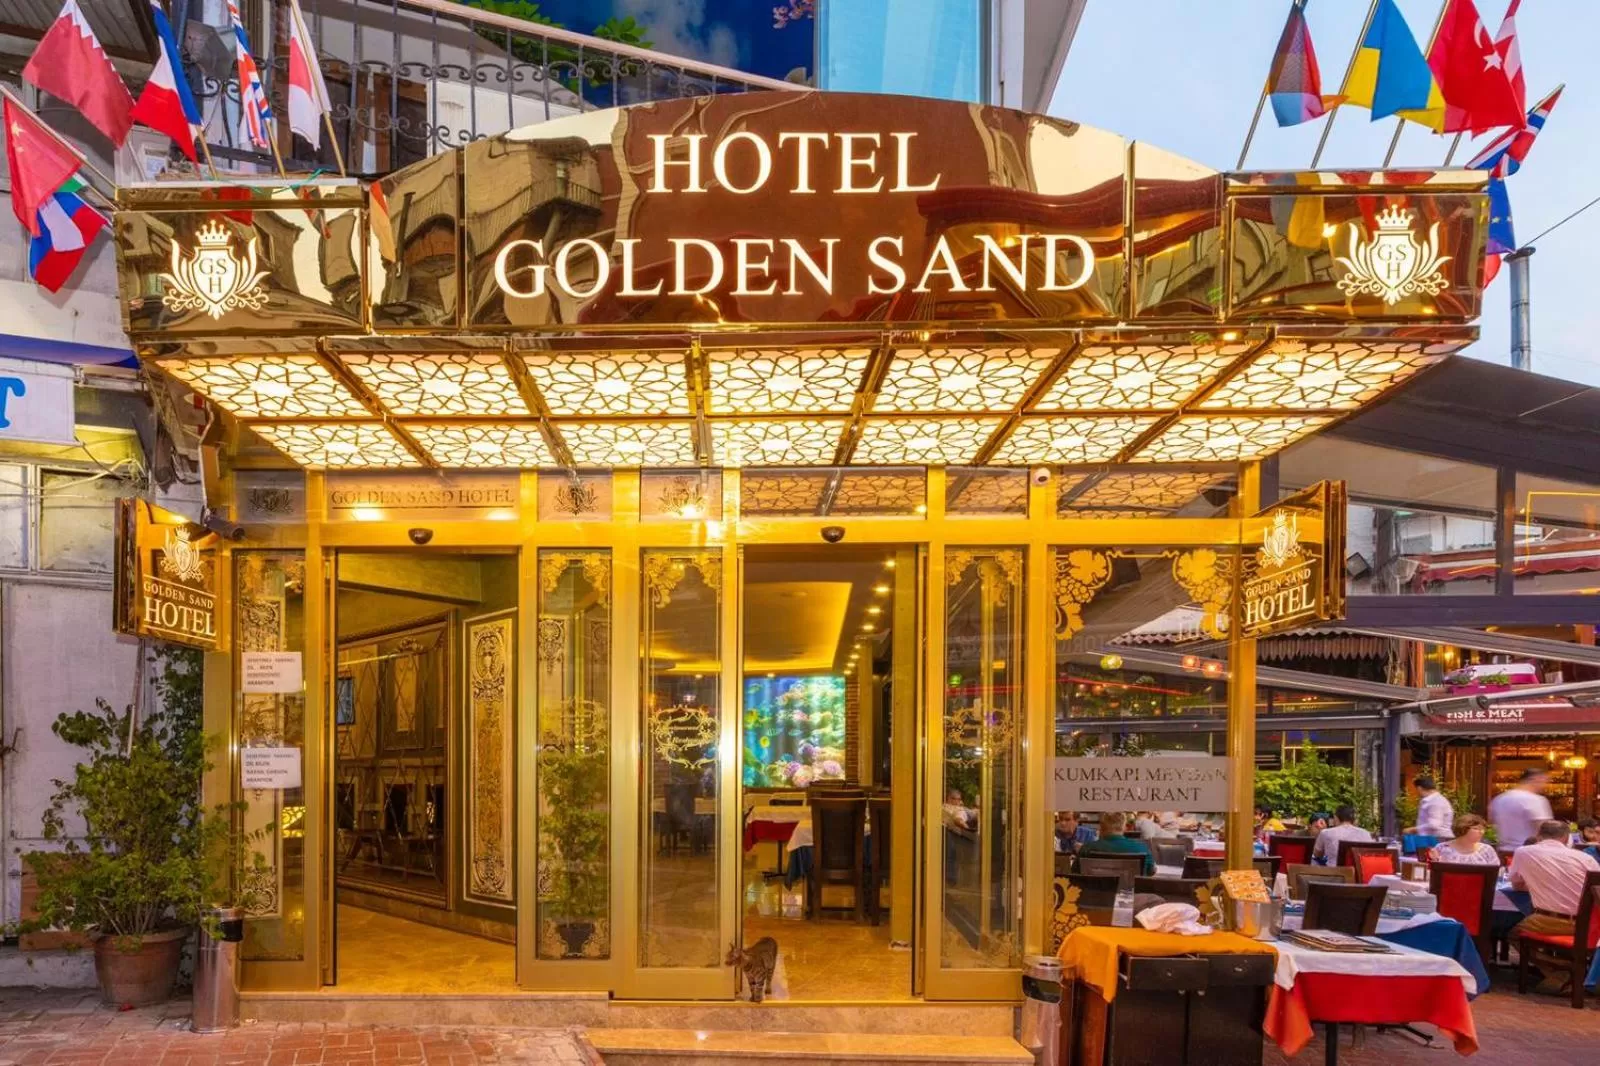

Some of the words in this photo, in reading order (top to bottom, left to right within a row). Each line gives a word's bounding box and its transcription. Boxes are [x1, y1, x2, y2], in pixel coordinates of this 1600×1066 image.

[646, 131, 942, 195] HOTEL
[493, 237, 841, 299] GOLDEN
[867, 234, 1097, 297] SAND
[330, 490, 402, 505] GOLDEN
[406, 489, 455, 504] SAND
[458, 488, 515, 504] HOTEL
[143, 580, 186, 601] GOLDEN
[189, 594, 214, 609] SAND
[1246, 579, 1282, 599] GOLDEN
[1285, 568, 1311, 587] SAND
[143, 595, 216, 637] HOTEL
[1245, 583, 1316, 627] HOTEL
[1475, 710, 1487, 718] &
[1488, 708, 1525, 718] MEAT
[1054, 767, 1140, 781] KUMKAPI
[1079, 787, 1202, 802] RESTAURANT
